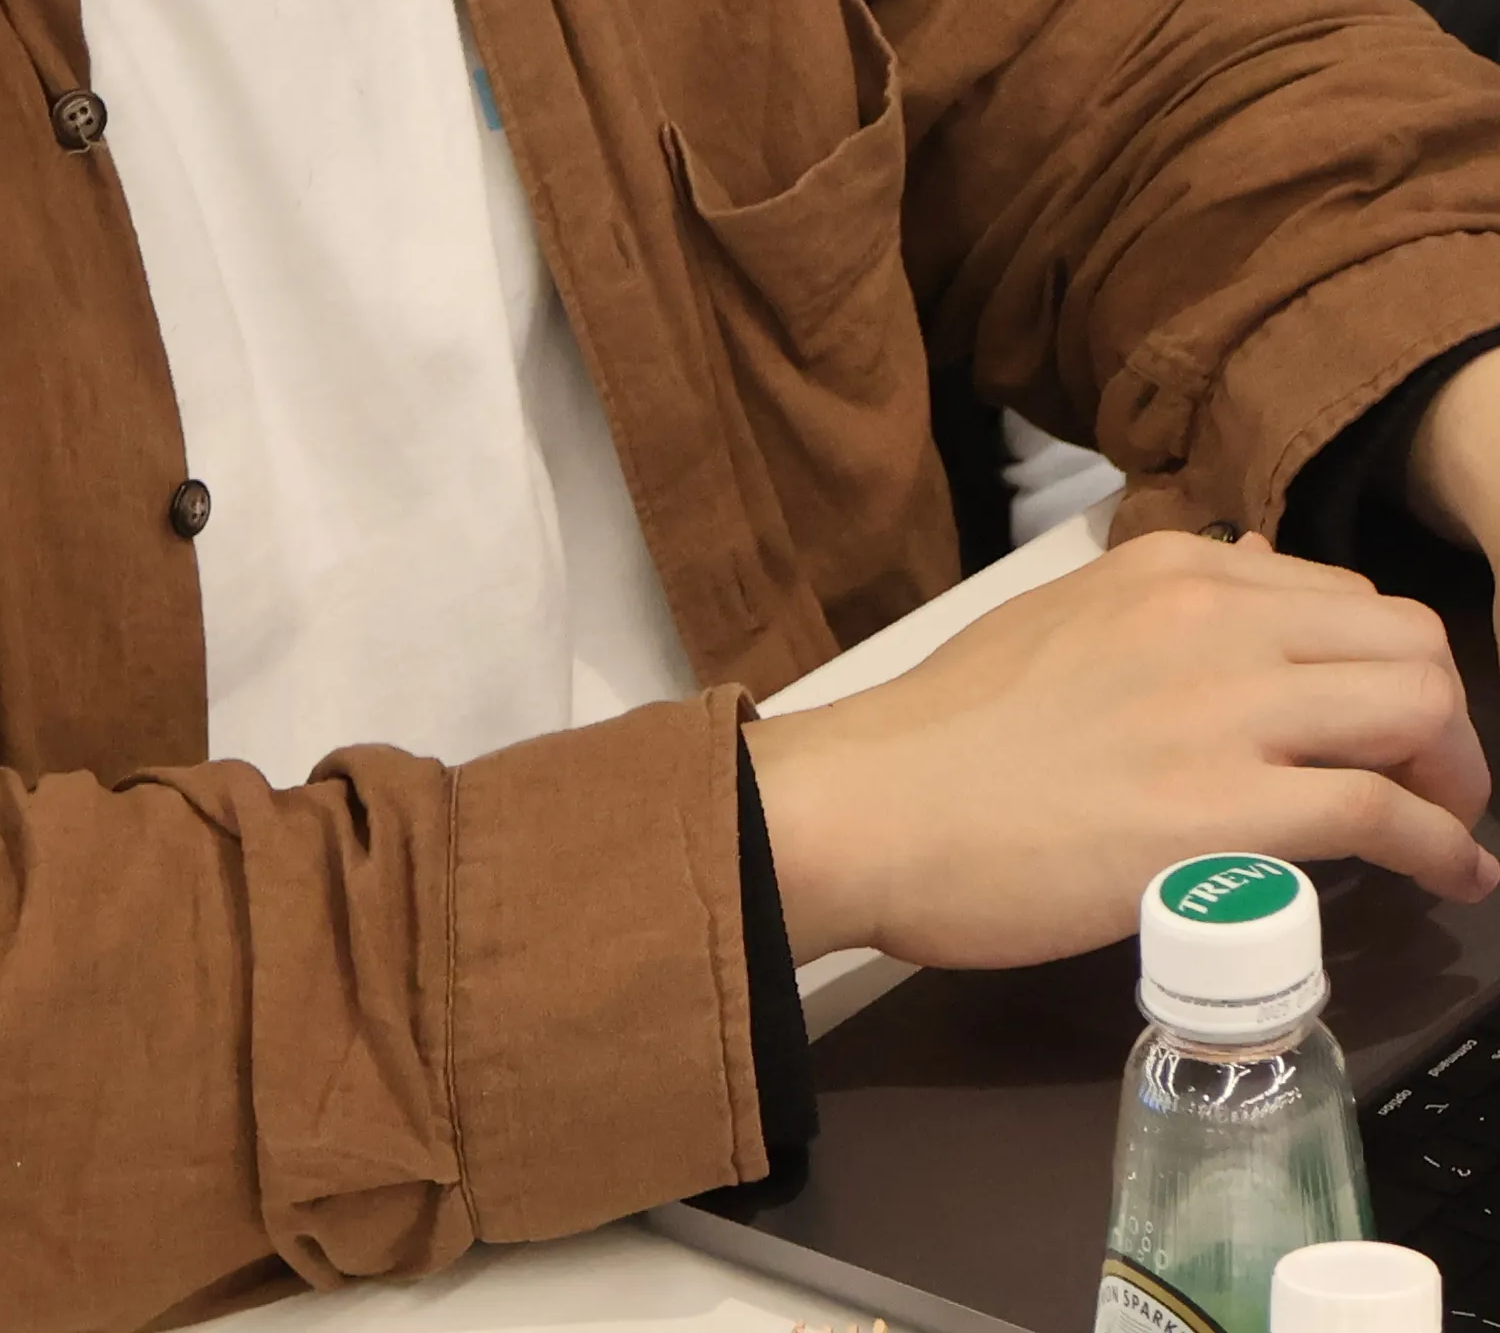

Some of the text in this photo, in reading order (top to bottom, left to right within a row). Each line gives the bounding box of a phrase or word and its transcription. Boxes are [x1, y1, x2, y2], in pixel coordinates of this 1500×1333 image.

[1178, 860, 1284, 916] TREVI
[1427, 1039, 1478, 1078] command
[1377, 1089, 1413, 1116] option
